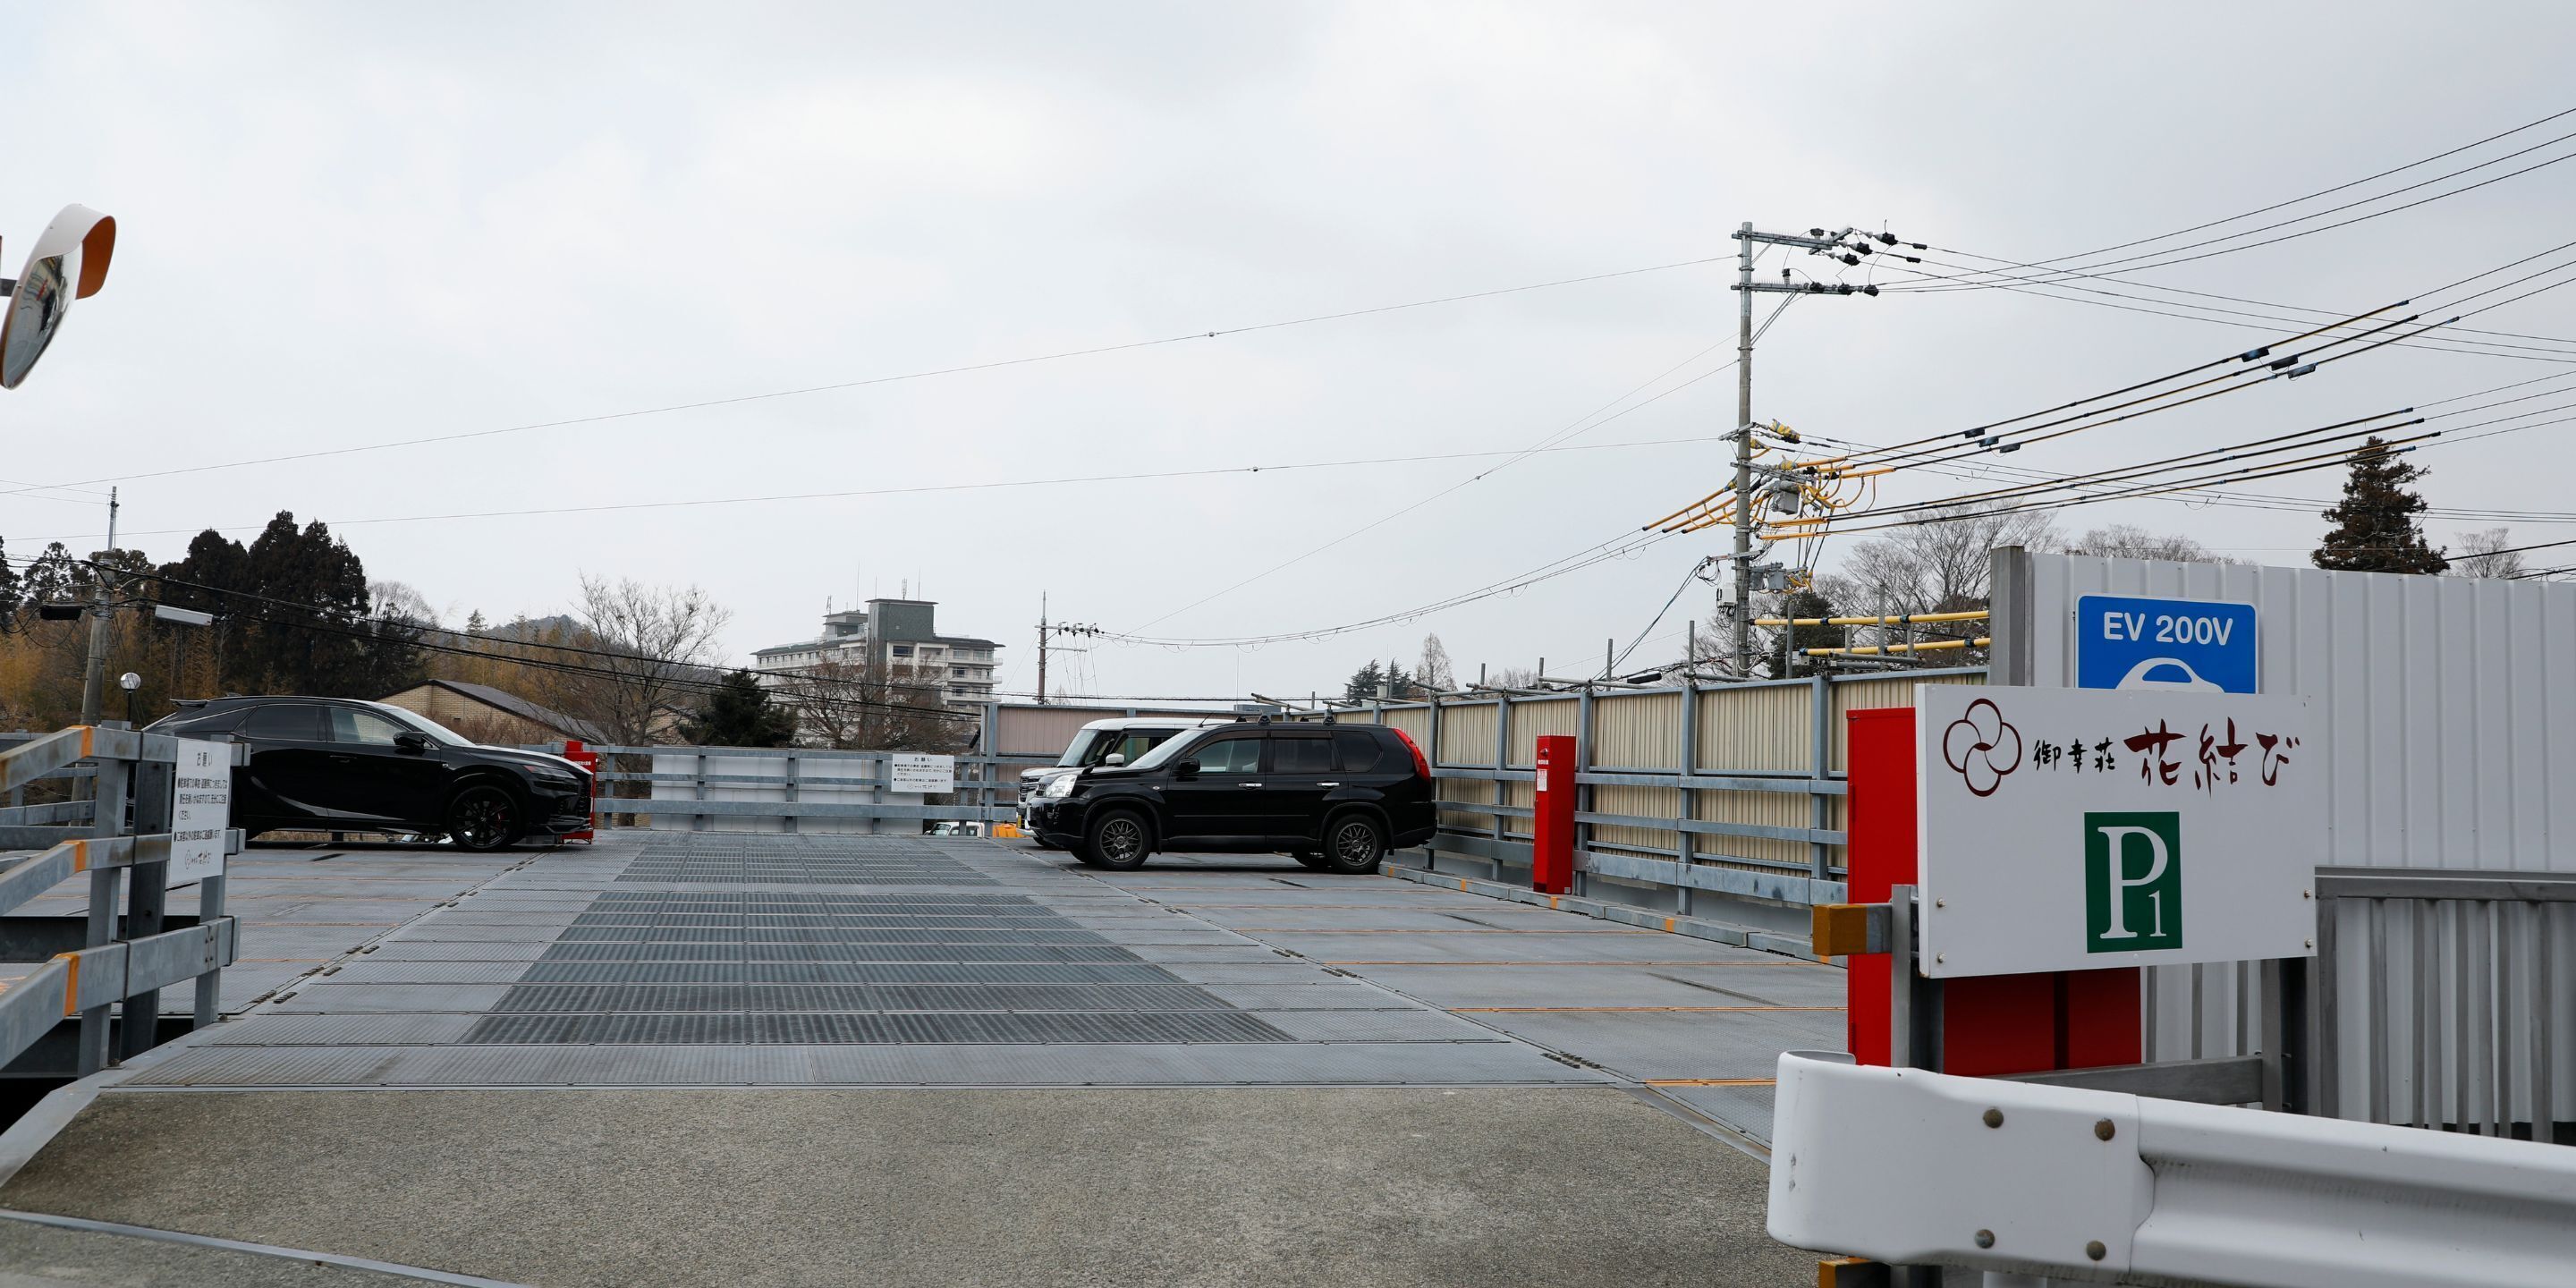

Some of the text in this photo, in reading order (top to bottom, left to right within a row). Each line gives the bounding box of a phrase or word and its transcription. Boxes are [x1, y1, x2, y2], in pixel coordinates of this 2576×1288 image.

[2105, 612, 2233, 645] EV 200V
[2034, 716, 2300, 796] 御幸荘 花結び
